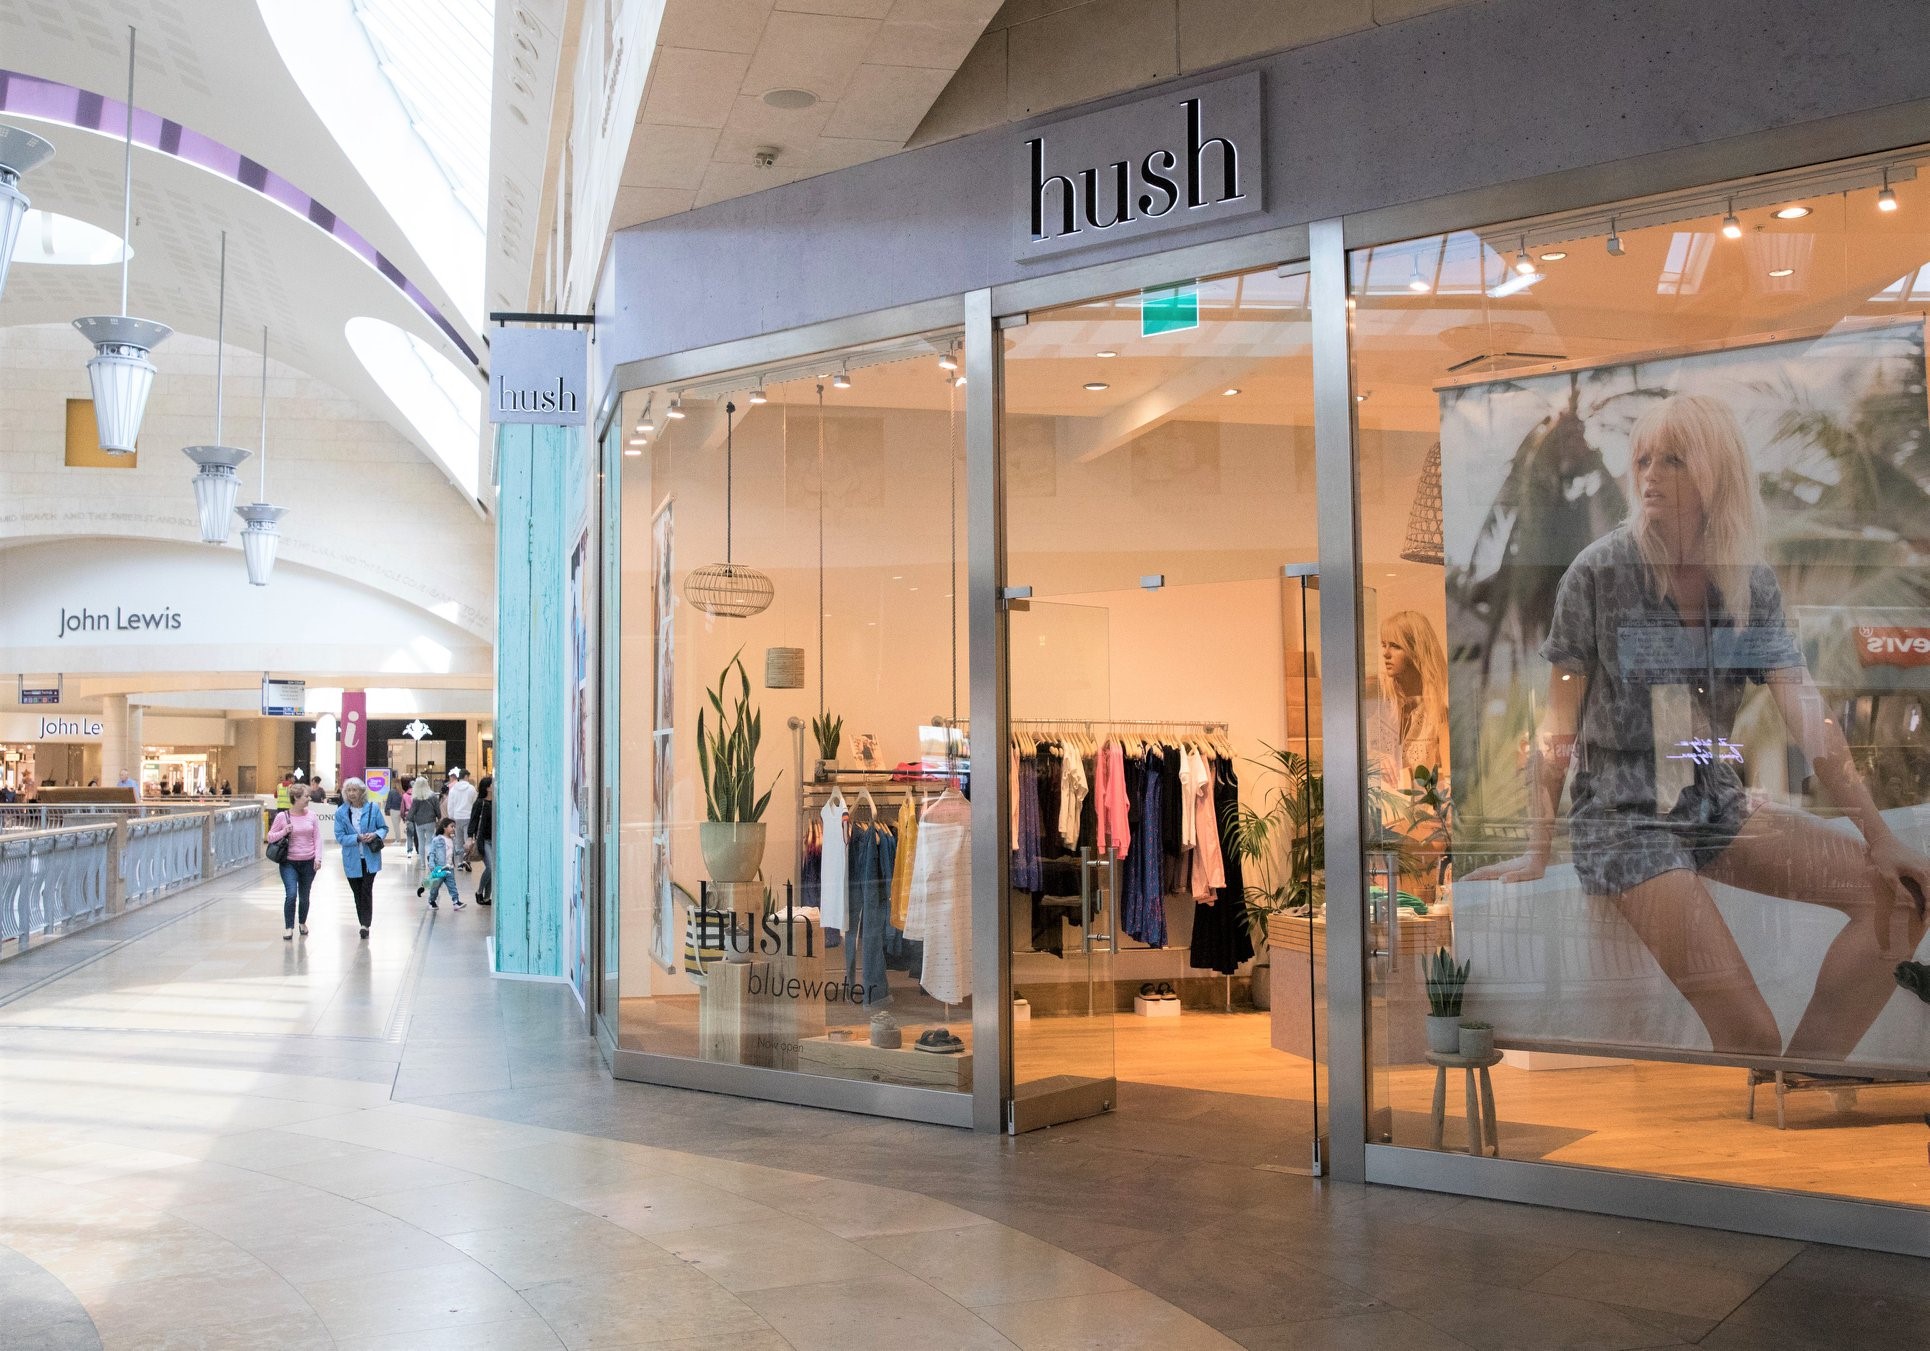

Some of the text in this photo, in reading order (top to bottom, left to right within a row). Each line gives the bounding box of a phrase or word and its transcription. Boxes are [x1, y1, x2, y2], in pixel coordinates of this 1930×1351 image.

[1024, 98, 1246, 243] hush
[497, 375, 579, 413] hush
[58, 606, 182, 638] John Lewis
[39, 717, 104, 739] John Le
[697, 878, 817, 958] hush
[747, 961, 878, 1005] bluewater
[756, 1036, 804, 1054] Now open
